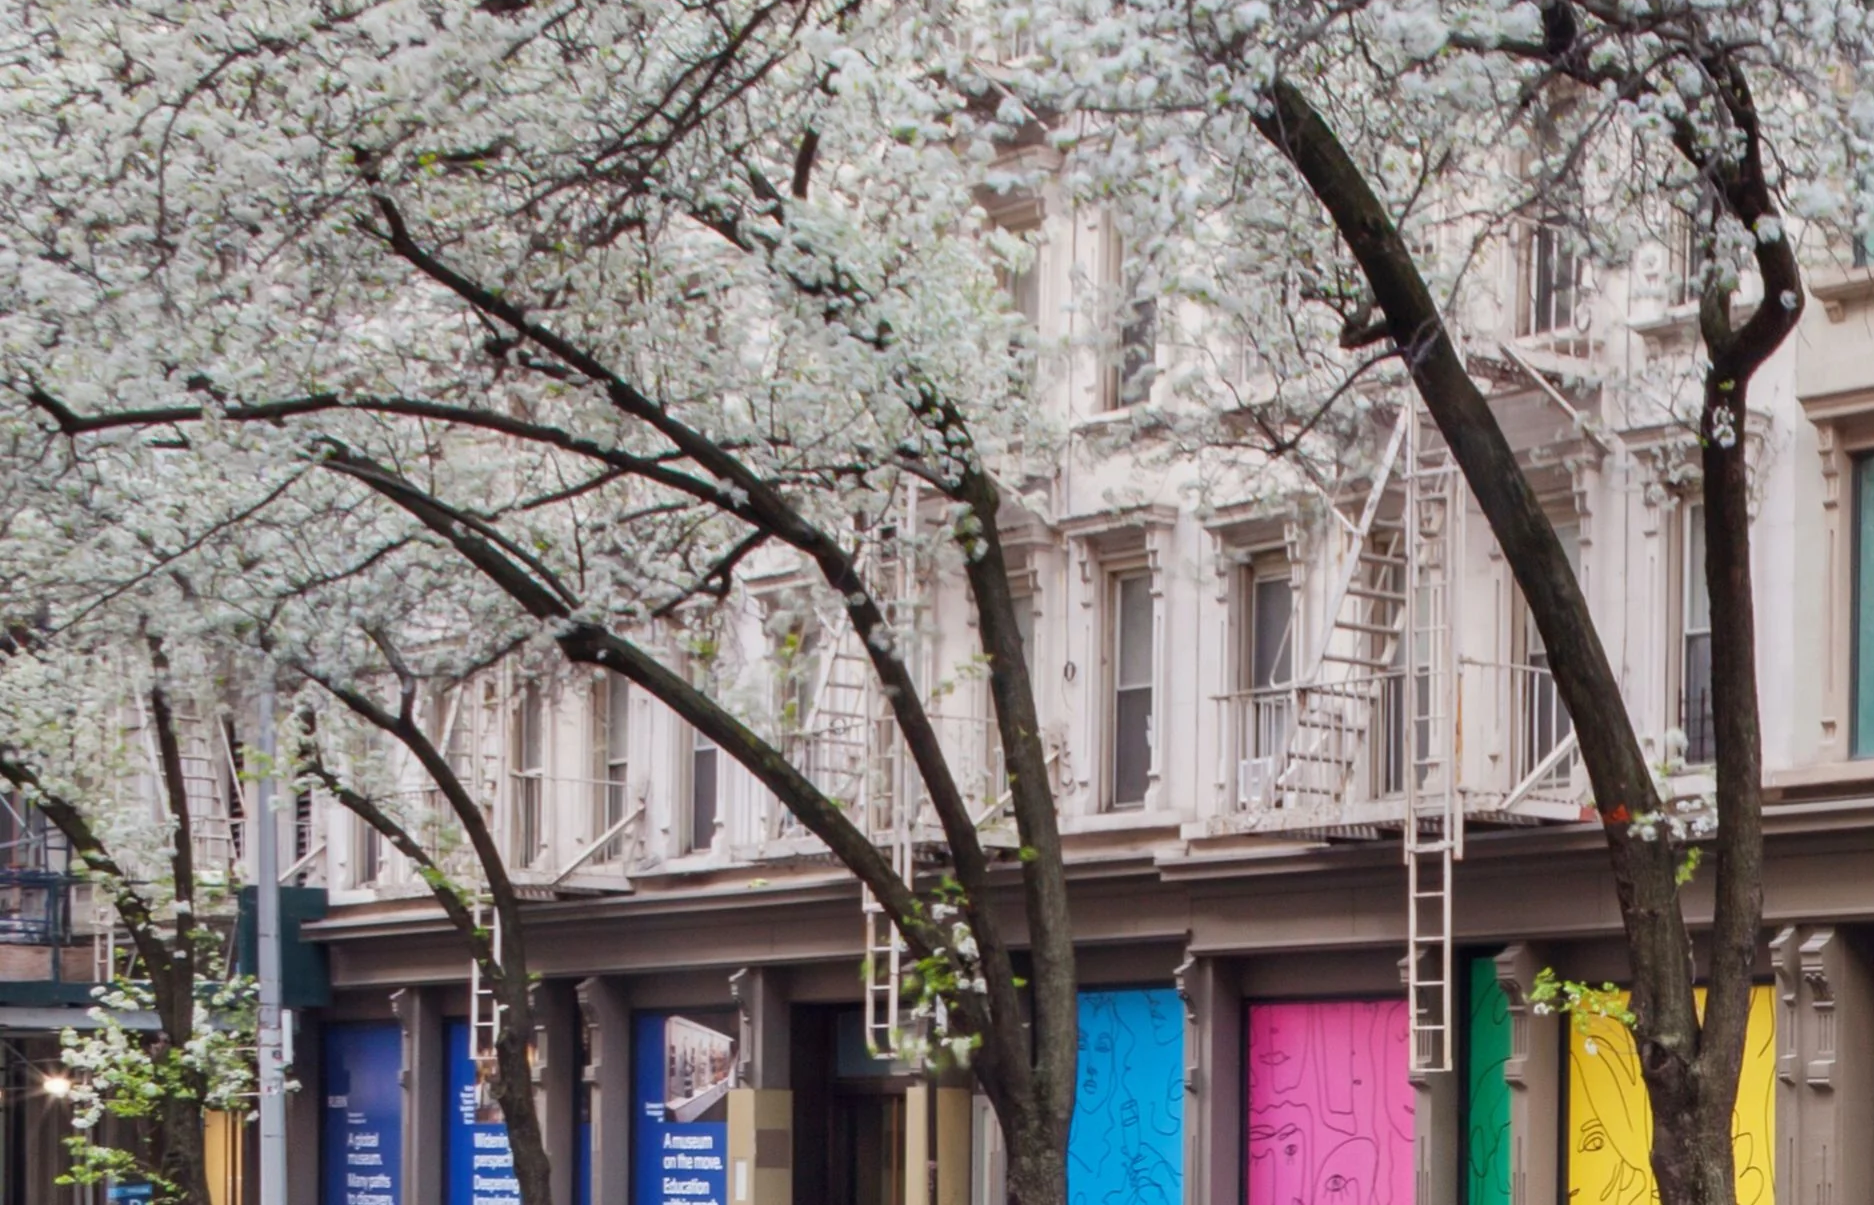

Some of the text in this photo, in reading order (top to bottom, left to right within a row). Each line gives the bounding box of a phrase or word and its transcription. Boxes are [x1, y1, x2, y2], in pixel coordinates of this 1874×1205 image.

[663, 1132, 713, 1150] A museum
[663, 1156, 676, 1170] on
[677, 1153, 693, 1169] the
[663, 1177, 710, 1195] Education
